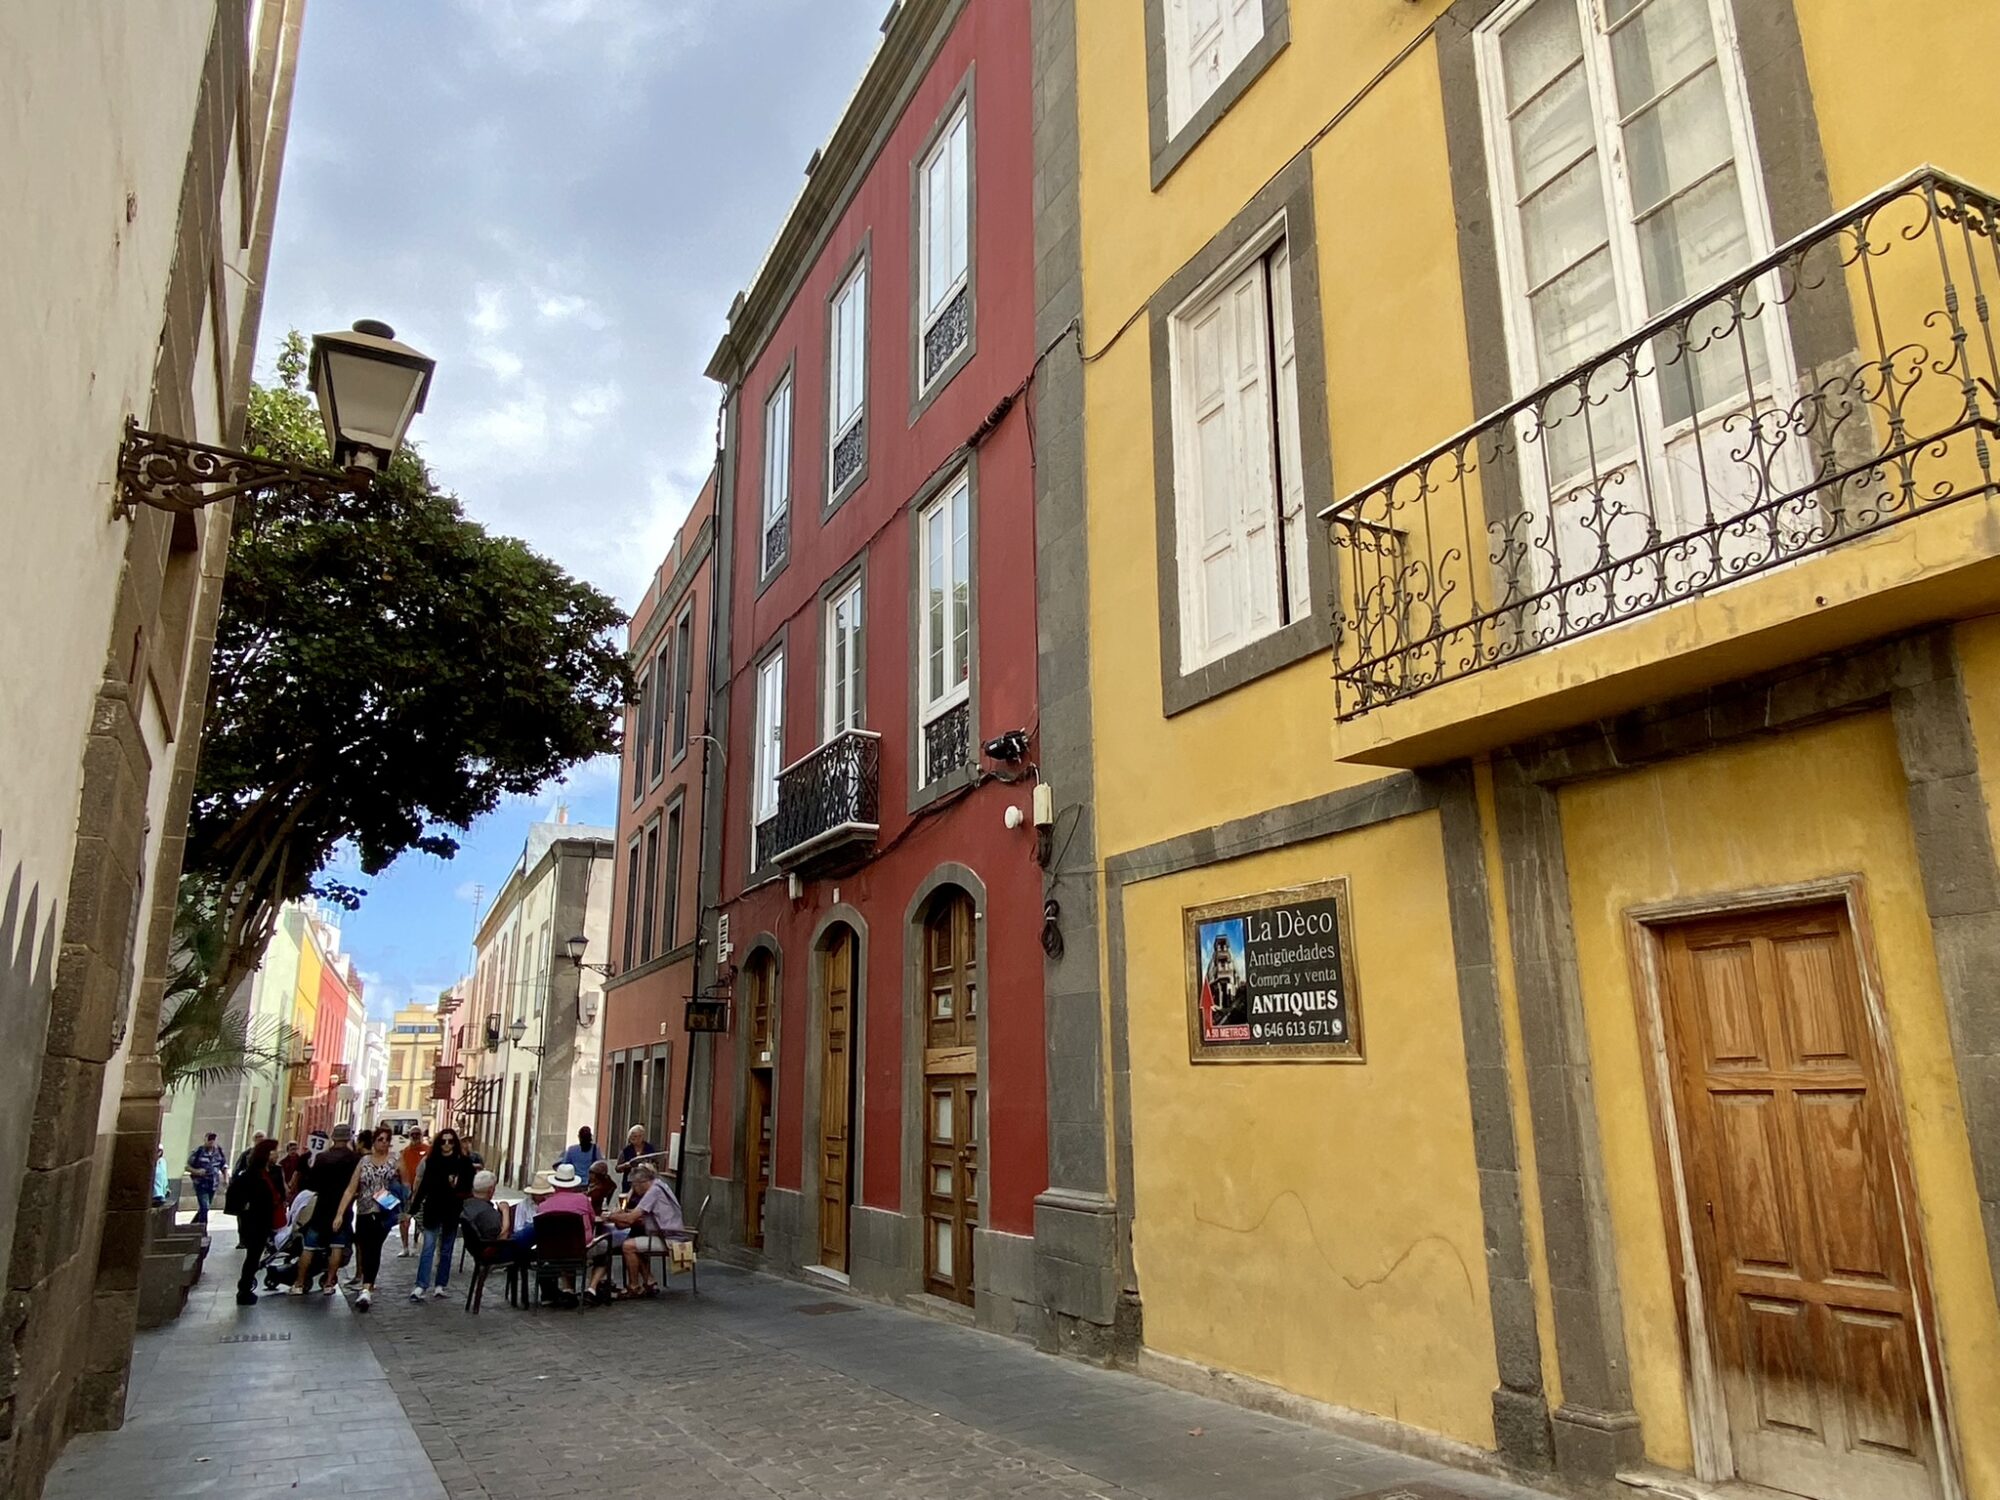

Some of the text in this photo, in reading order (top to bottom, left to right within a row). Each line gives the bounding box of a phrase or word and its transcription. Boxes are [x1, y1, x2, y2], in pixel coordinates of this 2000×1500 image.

[1246, 910, 1333, 943] La Dèco
[1248, 942, 1336, 967] Antigüedades
[1249, 968, 1337, 989] Compra y venta
[1251, 989, 1339, 1017] ANTIQUES
[1219, 1026, 1248, 1038] METROS
[1264, 1020, 1330, 1037] 646 613 671
